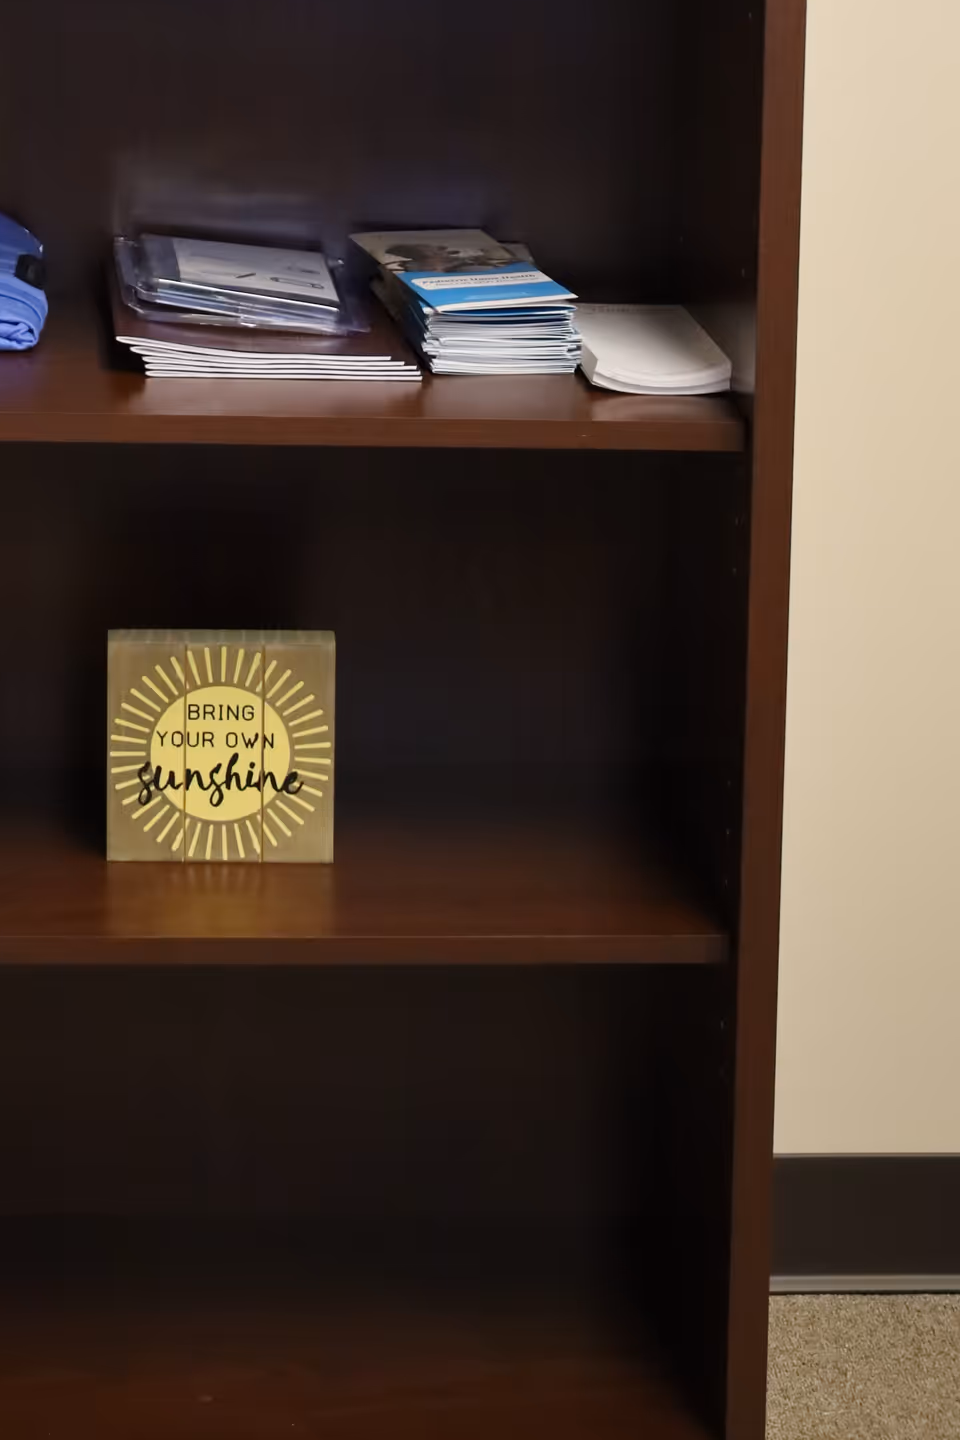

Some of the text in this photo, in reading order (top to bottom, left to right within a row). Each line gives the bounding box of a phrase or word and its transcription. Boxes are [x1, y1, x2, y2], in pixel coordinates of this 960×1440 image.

[187, 703, 255, 721] BRING
[156, 730, 275, 749] YOUR OWN
[137, 752, 305, 808] sunshine
